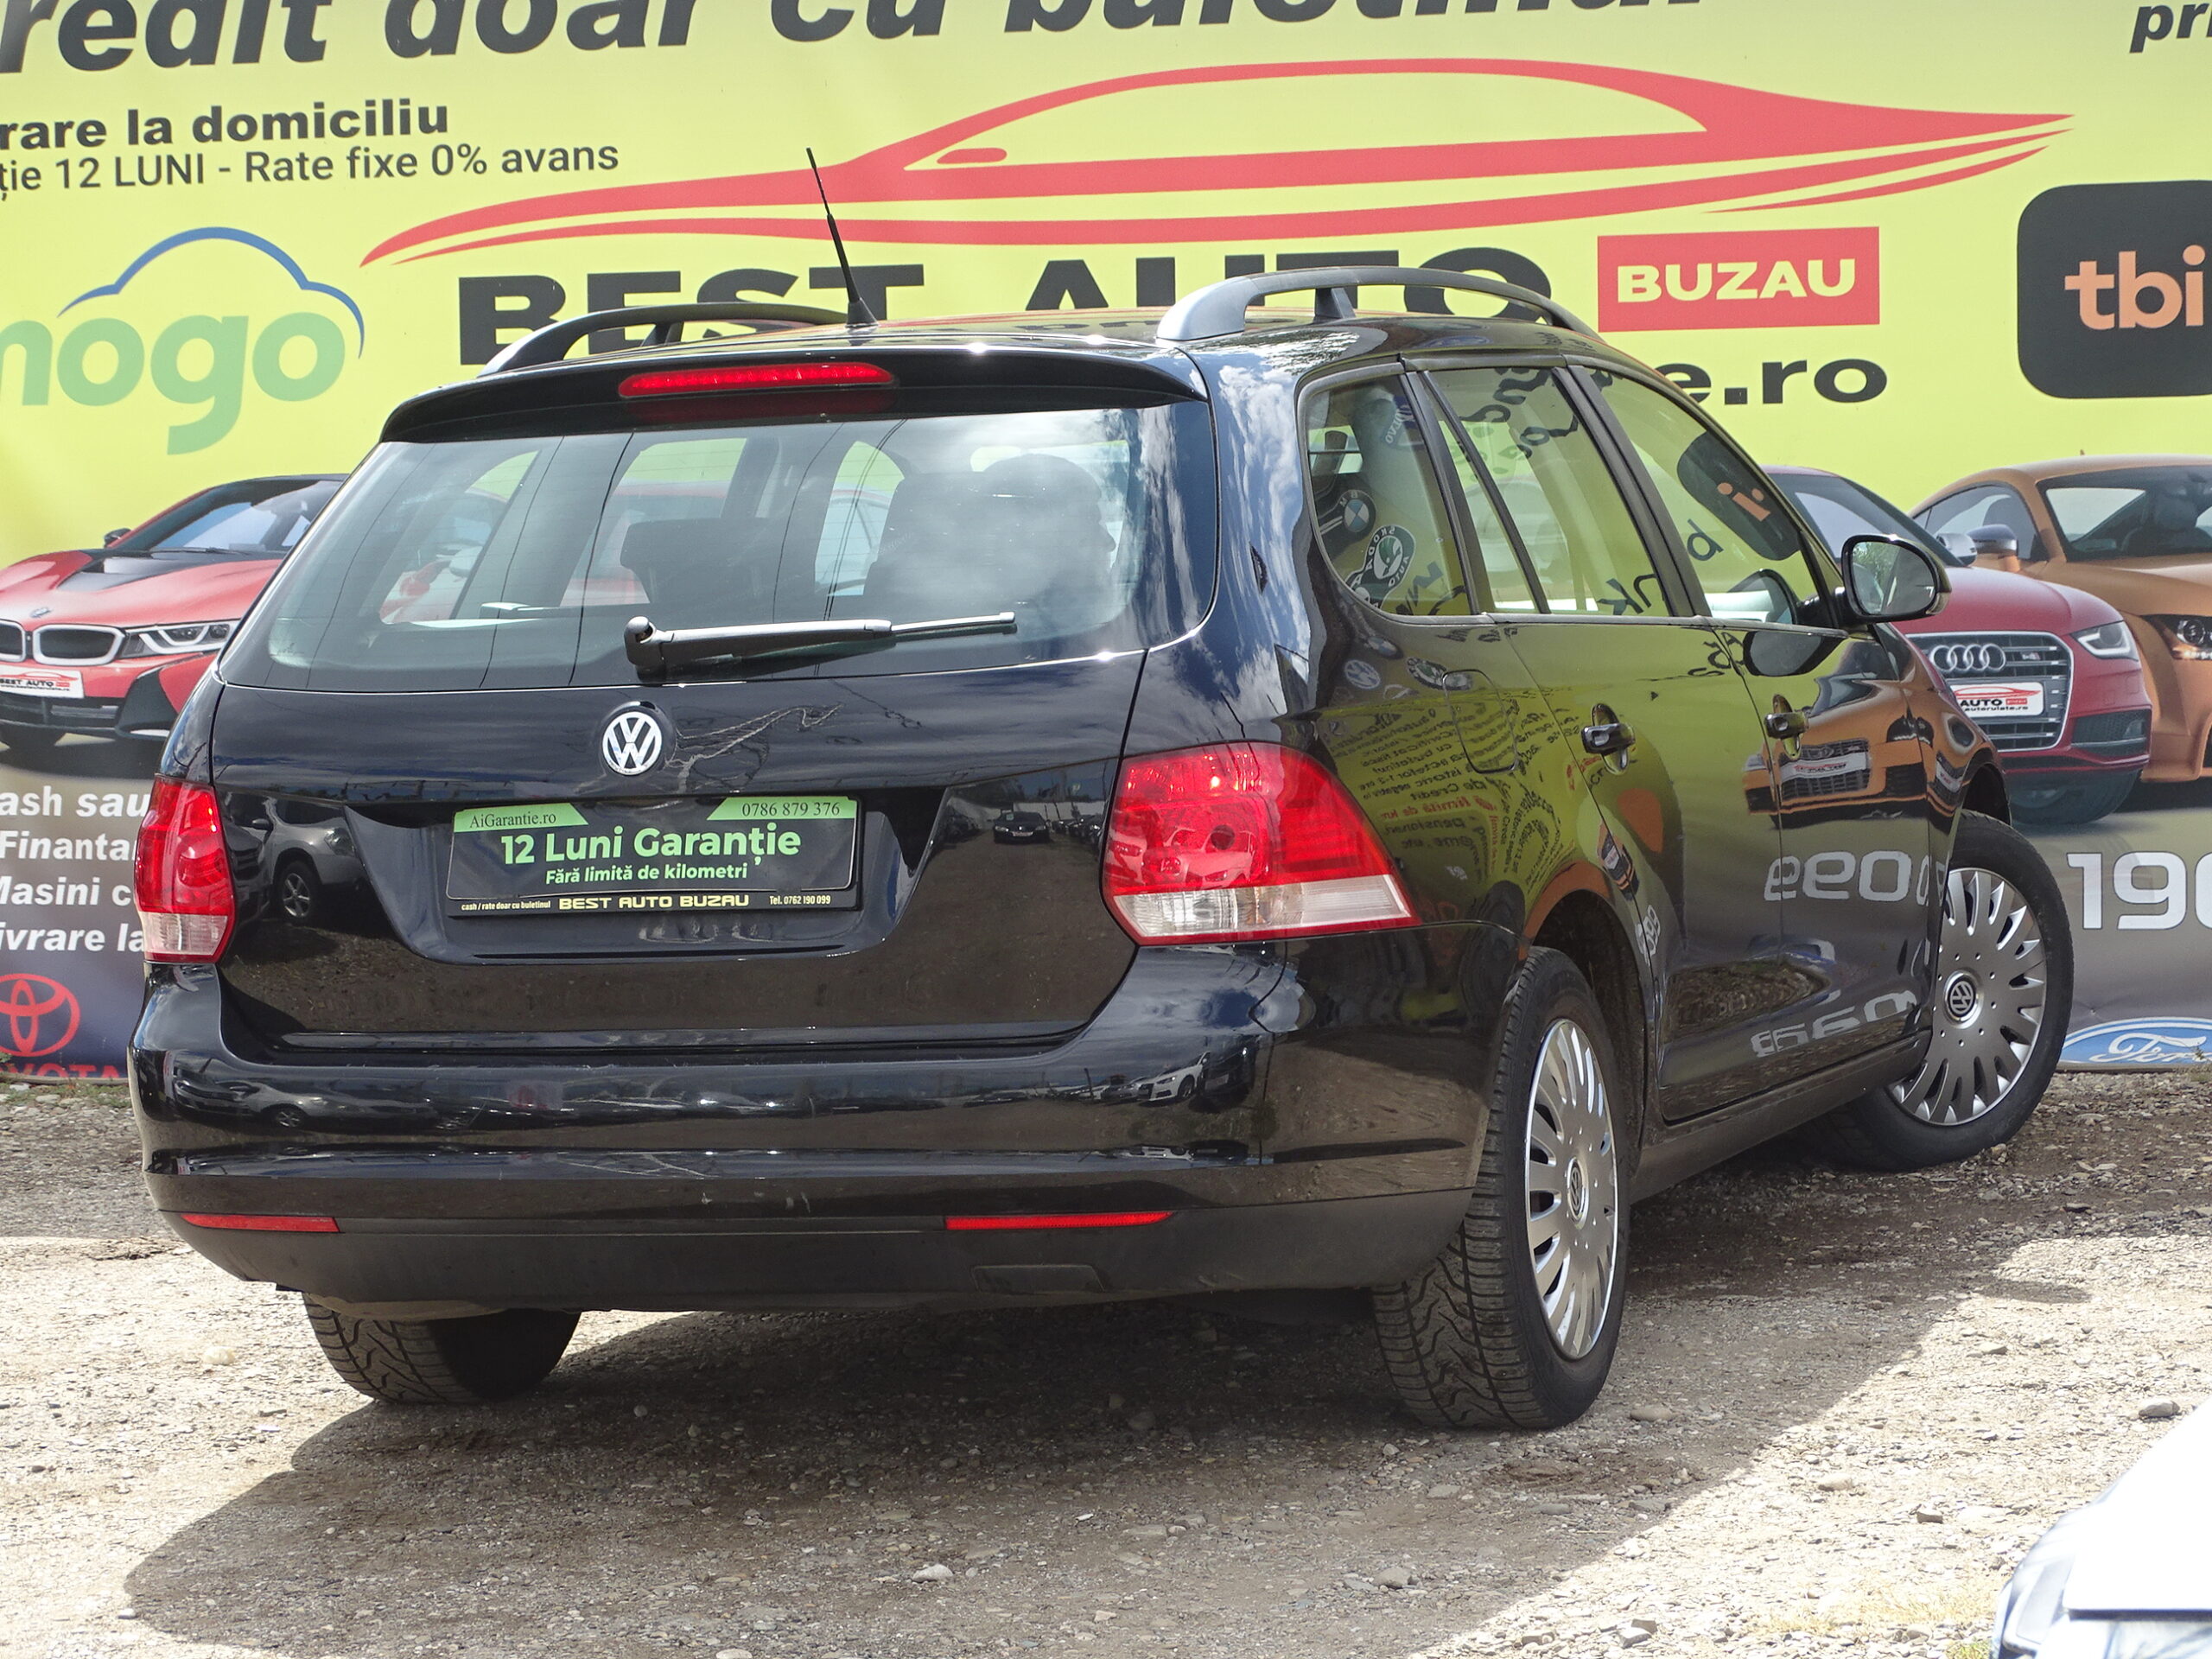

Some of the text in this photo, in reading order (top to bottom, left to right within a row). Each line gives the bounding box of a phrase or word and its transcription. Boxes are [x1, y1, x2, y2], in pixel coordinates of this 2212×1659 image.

[0, 98, 448, 150] rare la domiciliu
[54, 156, 101, 189] 12
[114, 152, 204, 187] LUNI
[245, 149, 334, 182] Rate
[345, 144, 417, 180] fixe
[431, 143, 488, 177] 0%
[500, 143, 620, 175] avans
[1616, 258, 1856, 304] BUZAU
[2064, 245, 2206, 330] tbi
[459, 264, 924, 365] BEST
[1960, 698, 2003, 707] AUTO
[0, 785, 151, 817] ash sau
[741, 801, 841, 817] 0786 879 376
[469, 810, 556, 830] AiGarantie.ro
[501, 822, 801, 866] 12 Luni Garanție
[545, 862, 748, 885] Fără limită de kilometri
[461, 903, 477, 912] cash
[481, 902, 496, 911] rate
[496, 901, 512, 910] doar
[520, 899, 551, 909] buletinul
[558, 894, 749, 910] BEST AUTO BUZAU
[769, 895, 831, 905] Tel. 0762 190 099
[117, 923, 144, 952] la
